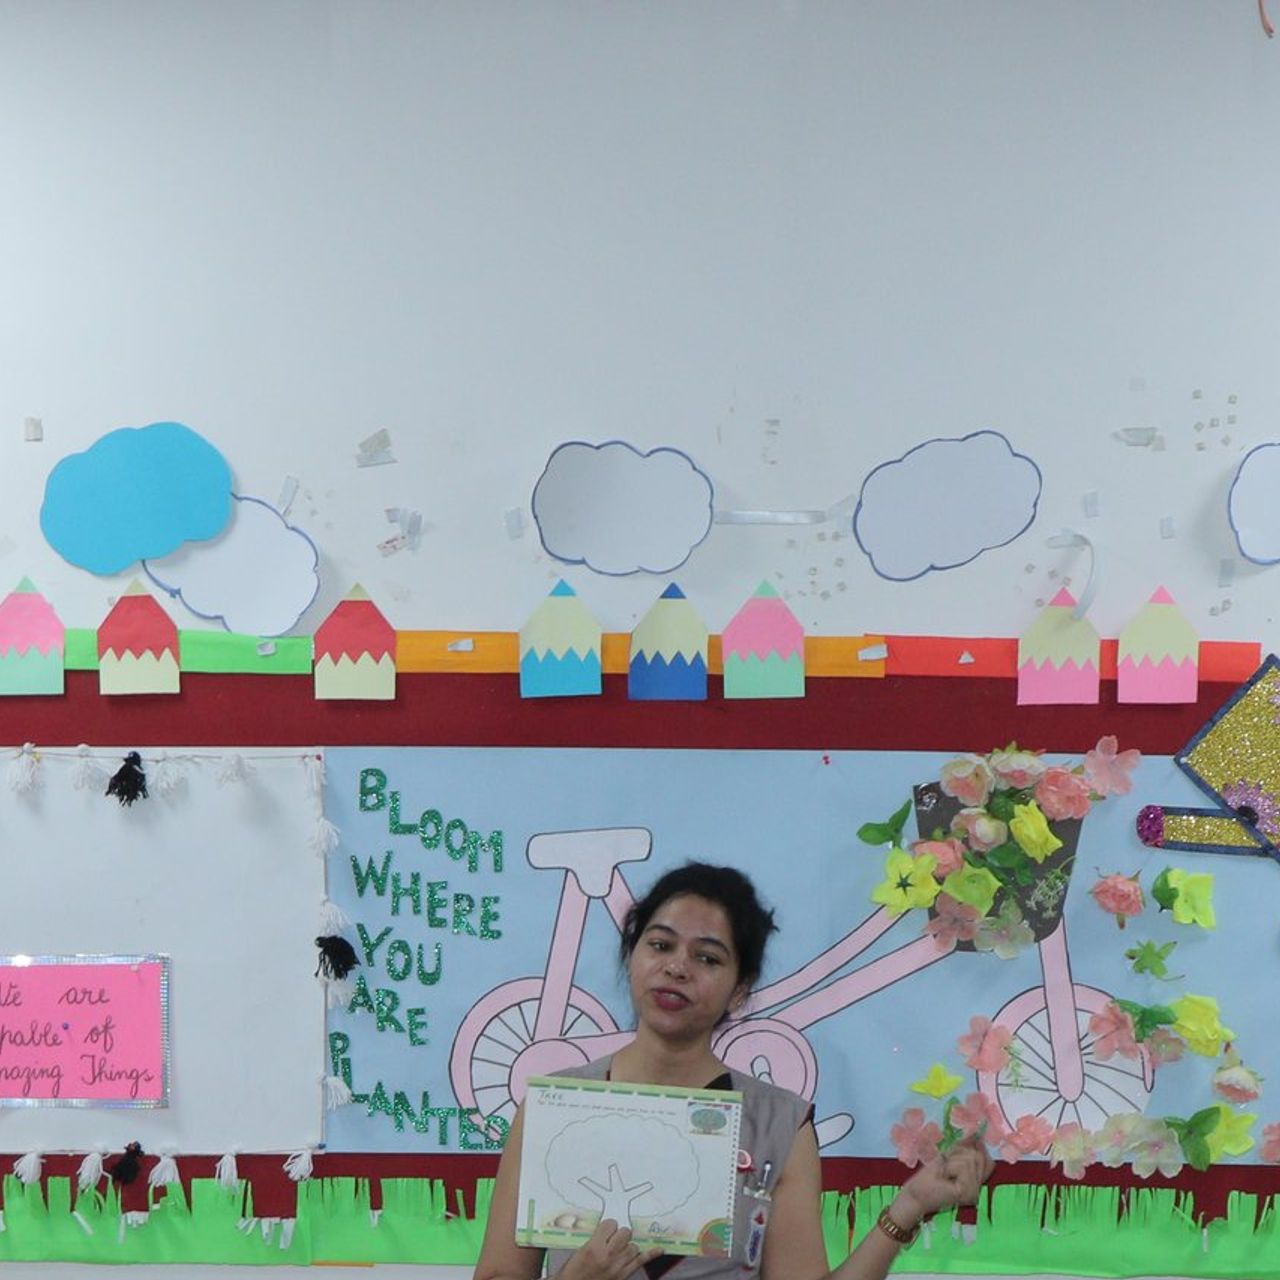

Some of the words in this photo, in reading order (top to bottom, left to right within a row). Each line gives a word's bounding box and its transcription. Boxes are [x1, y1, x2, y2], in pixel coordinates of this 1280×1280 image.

[358, 767, 504, 873] BLOOM
[349, 850, 503, 941] WHERE
[355, 922, 443, 986] YOU
[58, 986, 111, 1005] are
[346, 975, 429, 1047] ARE
[84, 1015, 115, 1053] of
[80, 1054, 155, 1098] Things
[328, 1030, 510, 1151] PLANTED
